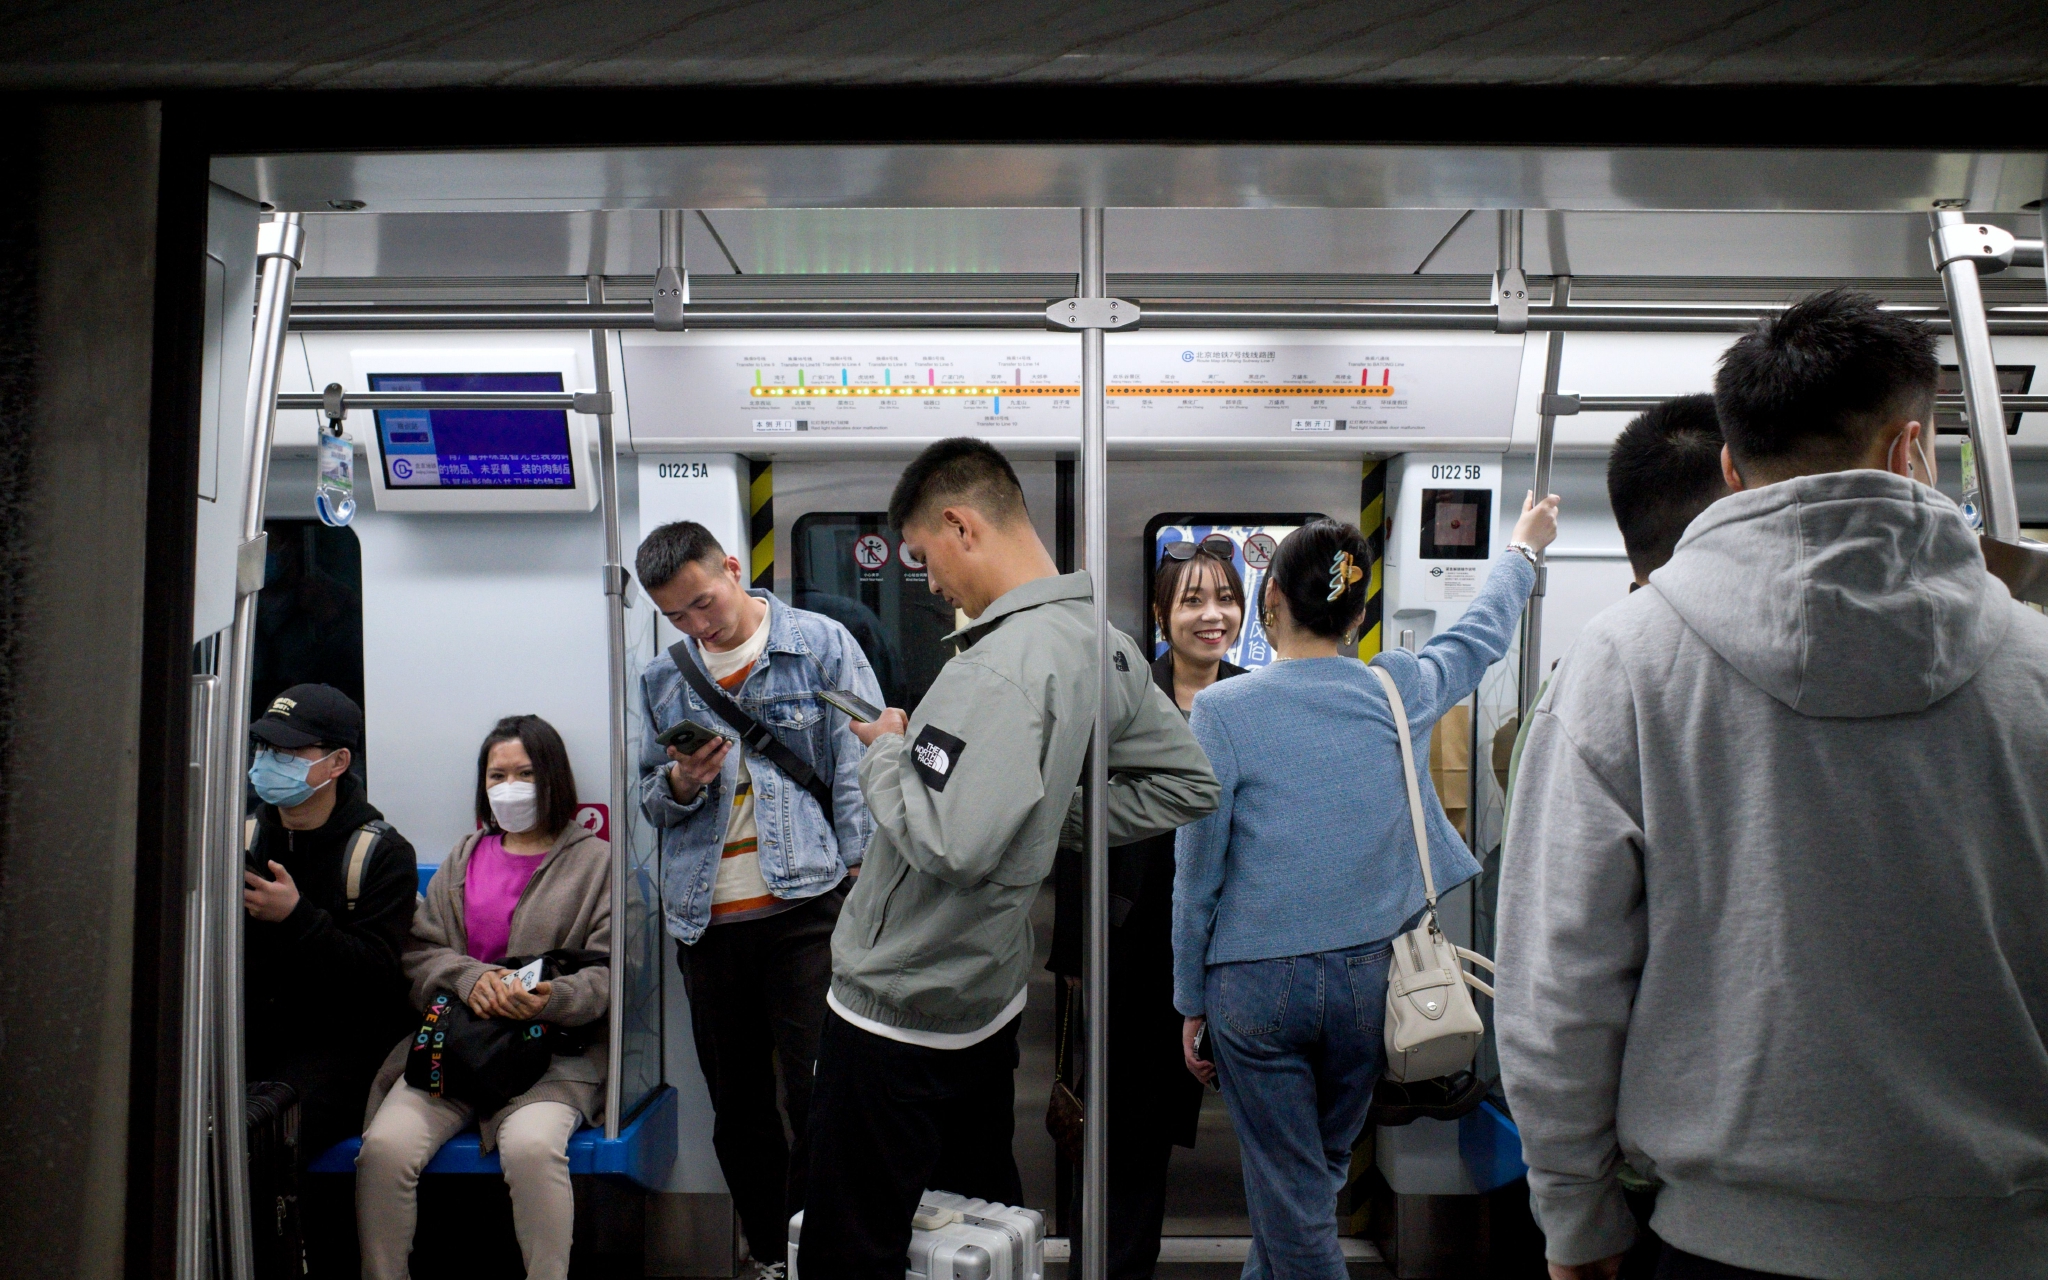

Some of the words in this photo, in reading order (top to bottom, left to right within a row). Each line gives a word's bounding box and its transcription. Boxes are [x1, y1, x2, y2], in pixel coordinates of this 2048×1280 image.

[438, 463, 570, 475] 的物品、未妥善装的肉制品
[659, 463, 689, 478] 0122
[692, 463, 709, 478] 5A
[1431, 465, 1461, 480] 0122
[1465, 465, 1481, 480] 5B
[915, 744, 938, 761] NORTH
[927, 742, 940, 754] THE
[917, 753, 935, 768] FACE
[522, 1024, 549, 1041] LOV
[431, 1053, 441, 1088] LOVE
